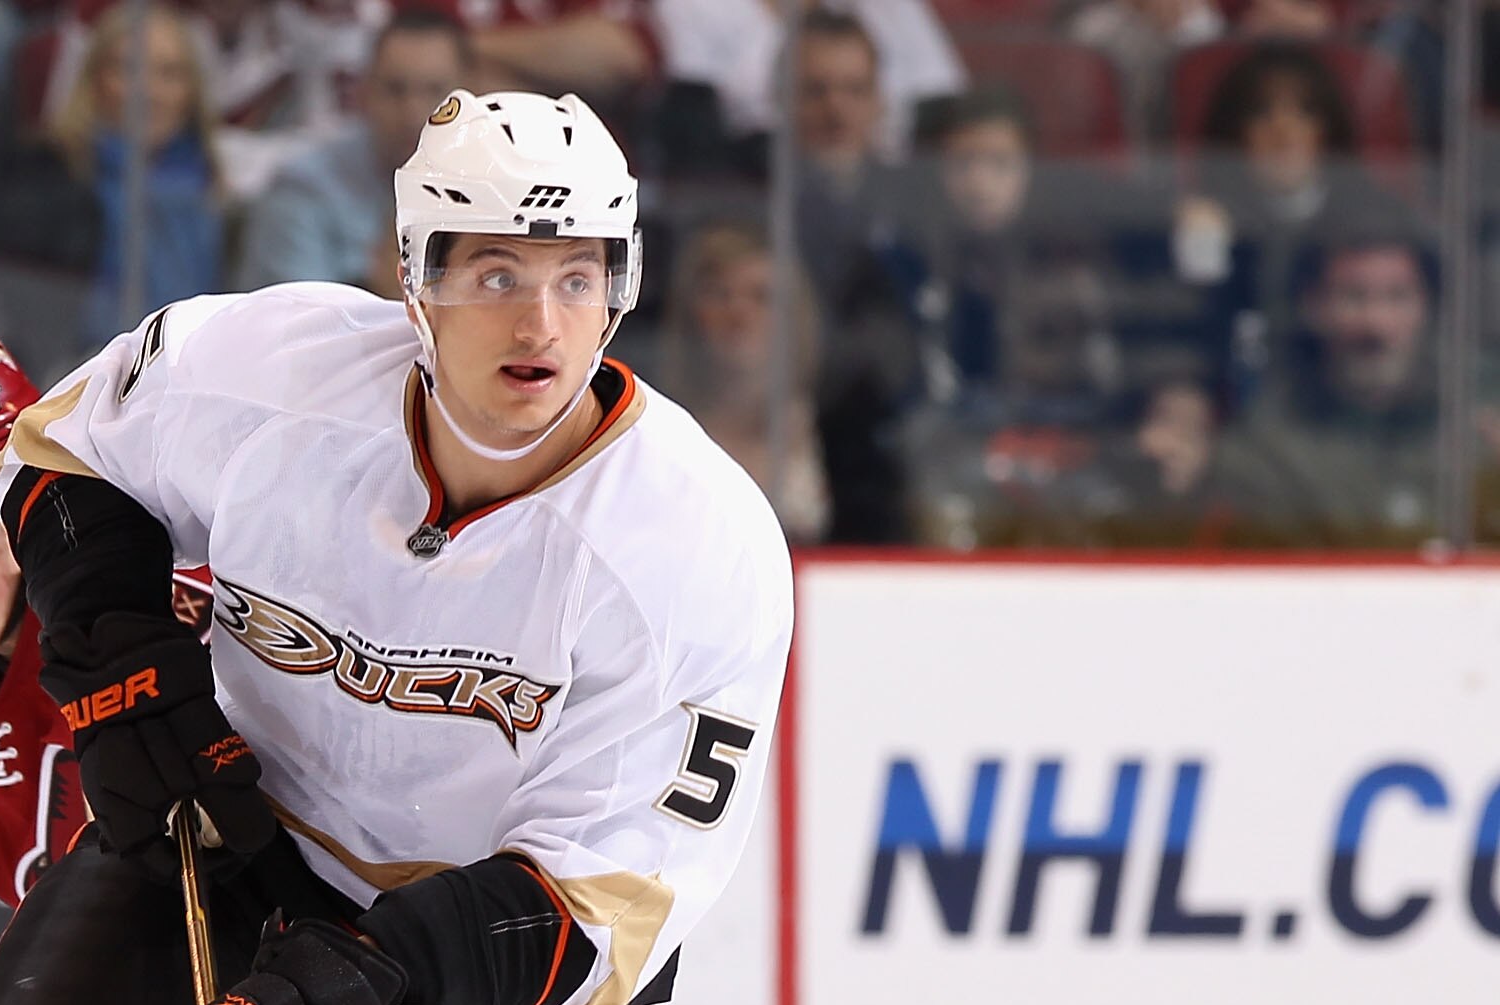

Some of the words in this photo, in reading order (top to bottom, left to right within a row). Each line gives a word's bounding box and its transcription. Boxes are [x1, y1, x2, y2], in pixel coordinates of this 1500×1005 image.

[212, 577, 563, 757] DUCKS
[346, 629, 517, 666] ANAHEIM
[653, 701, 760, 831] 5
[857, 757, 1500, 942] NHL.C
